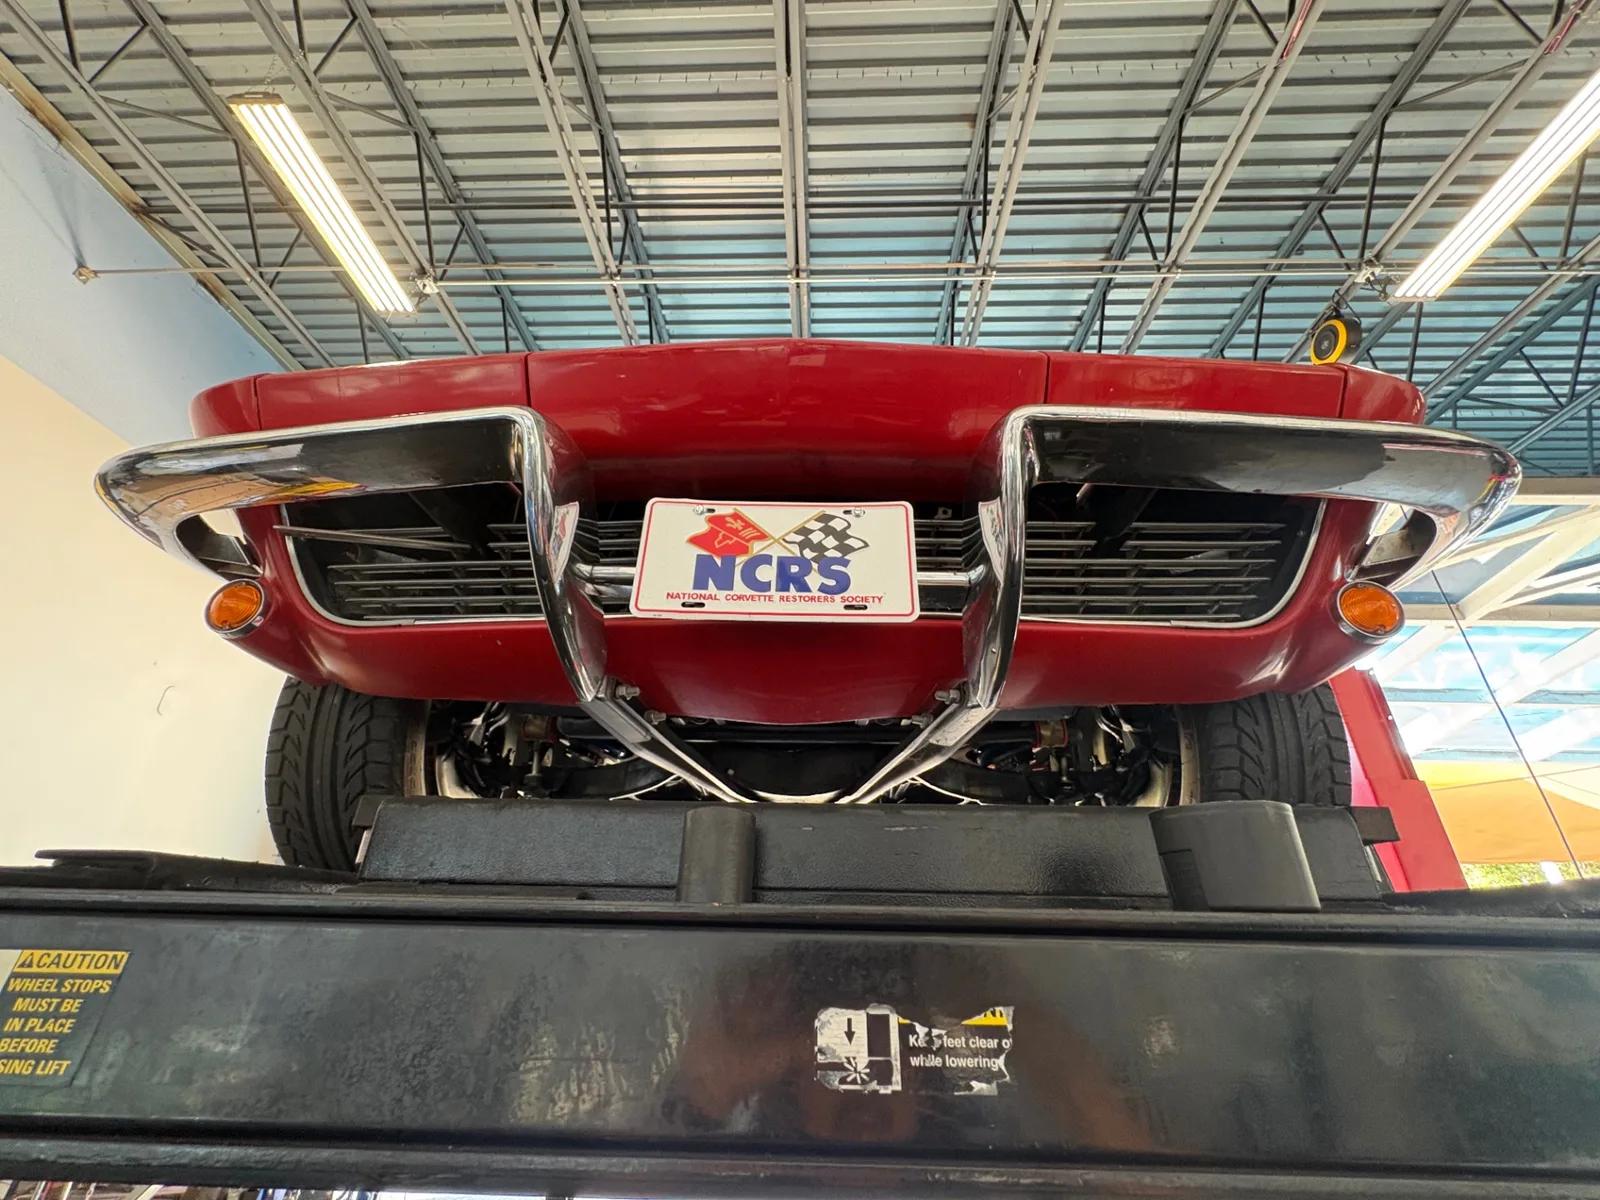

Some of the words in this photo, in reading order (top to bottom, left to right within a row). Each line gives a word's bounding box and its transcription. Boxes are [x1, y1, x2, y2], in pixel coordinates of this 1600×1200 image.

[692, 554, 851, 595] NCRS
[666, 591, 721, 602] NATIONAL
[725, 593, 774, 603] CORVETTE
[779, 594, 835, 604] RESTORERS
[840, 595, 884, 605] SOCIETY
[37, 953, 124, 969] CAUTION
[8, 978, 58, 992] WHEEL
[62, 979, 111, 993] STOPS
[13, 998, 60, 1011] MUST
[60, 999, 83, 1012] BE
[4, 1018, 24, 1031] IN
[25, 1019, 75, 1032] PLACE
[0, 1038, 58, 1053] BEFORE
[943, 1035, 966, 1048] feet
[969, 1036, 999, 1048] clear
[36, 1060, 71, 1074] LIFT
[910, 1054, 942, 1068] while
[945, 1054, 999, 1071] lowering
